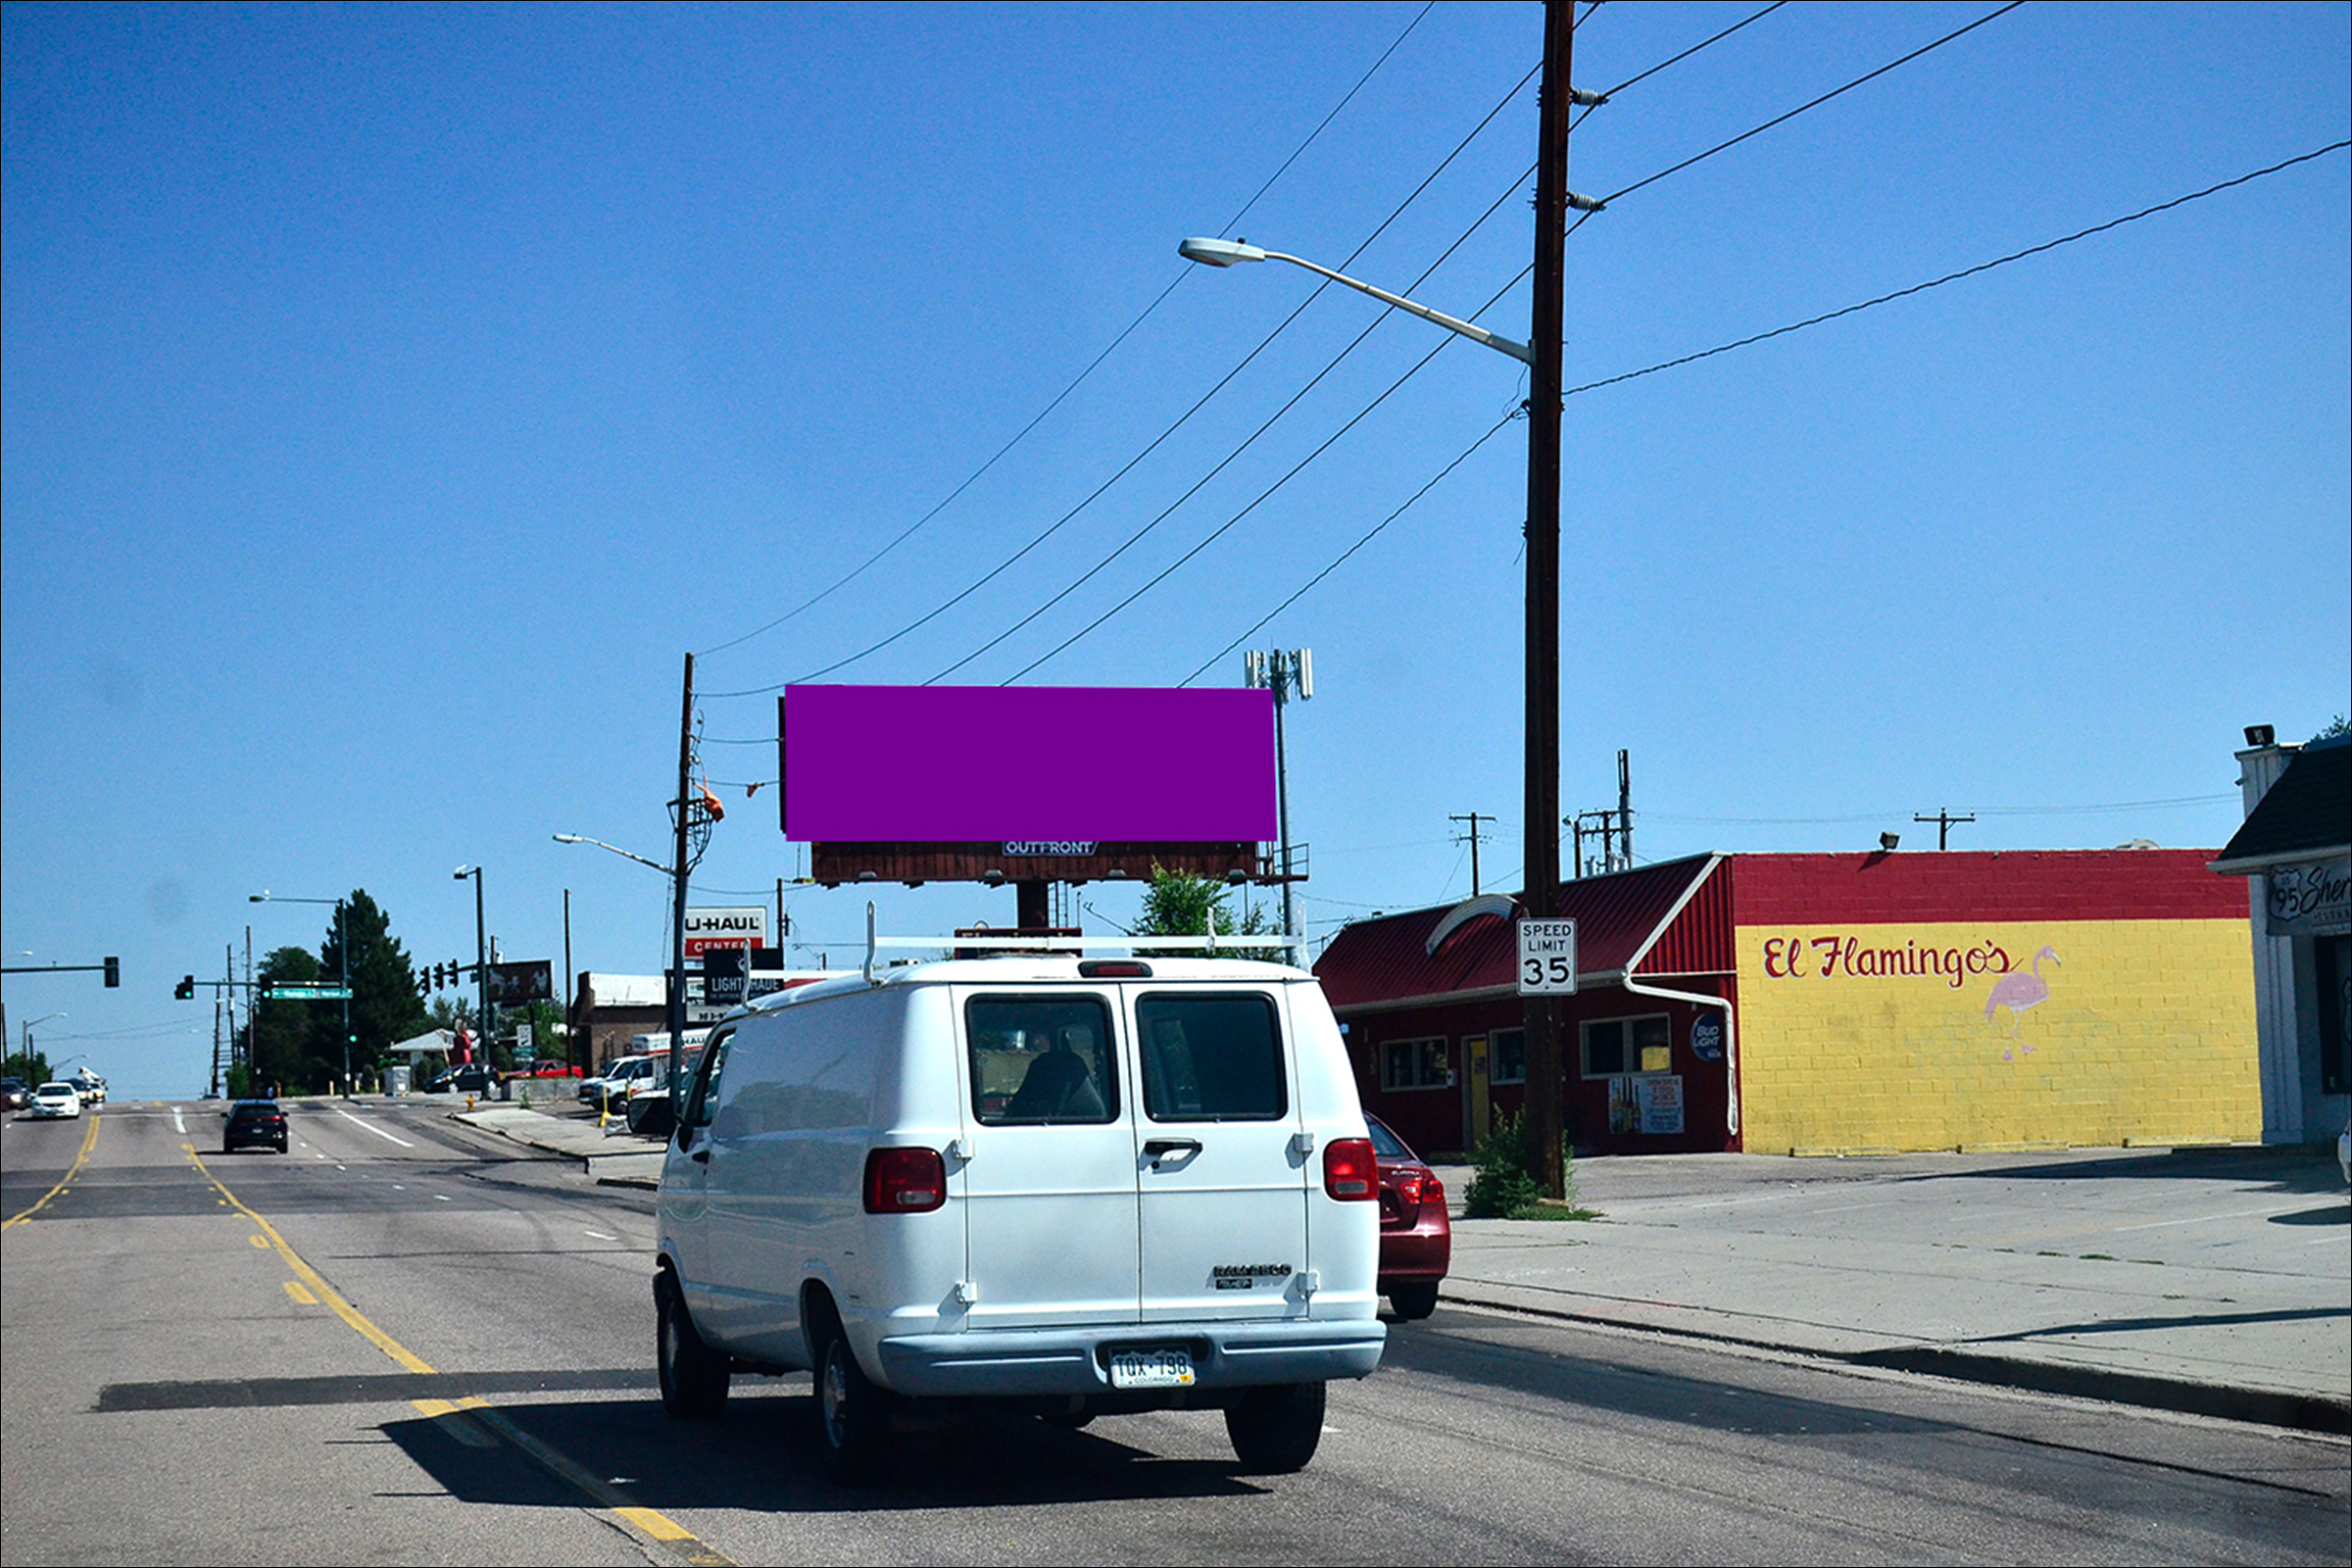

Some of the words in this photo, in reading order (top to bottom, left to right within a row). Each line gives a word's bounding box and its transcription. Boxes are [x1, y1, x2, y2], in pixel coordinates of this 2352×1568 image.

[2276, 887, 2299, 912] 95
[2299, 865, 2351, 914] Sher
[685, 916, 760, 931] U-HAUL
[1523, 924, 1572, 937] SPEED
[1528, 940, 1566, 952] LIMIT
[1763, 937, 1808, 979] El
[1810, 936, 2025, 989] Flamingo's
[1524, 956, 1570, 986] 35
[710, 977, 780, 993] LIGHTHADE
[1696, 1025, 1719, 1037] BUD
[1693, 1036, 1721, 1048] LIGHT
